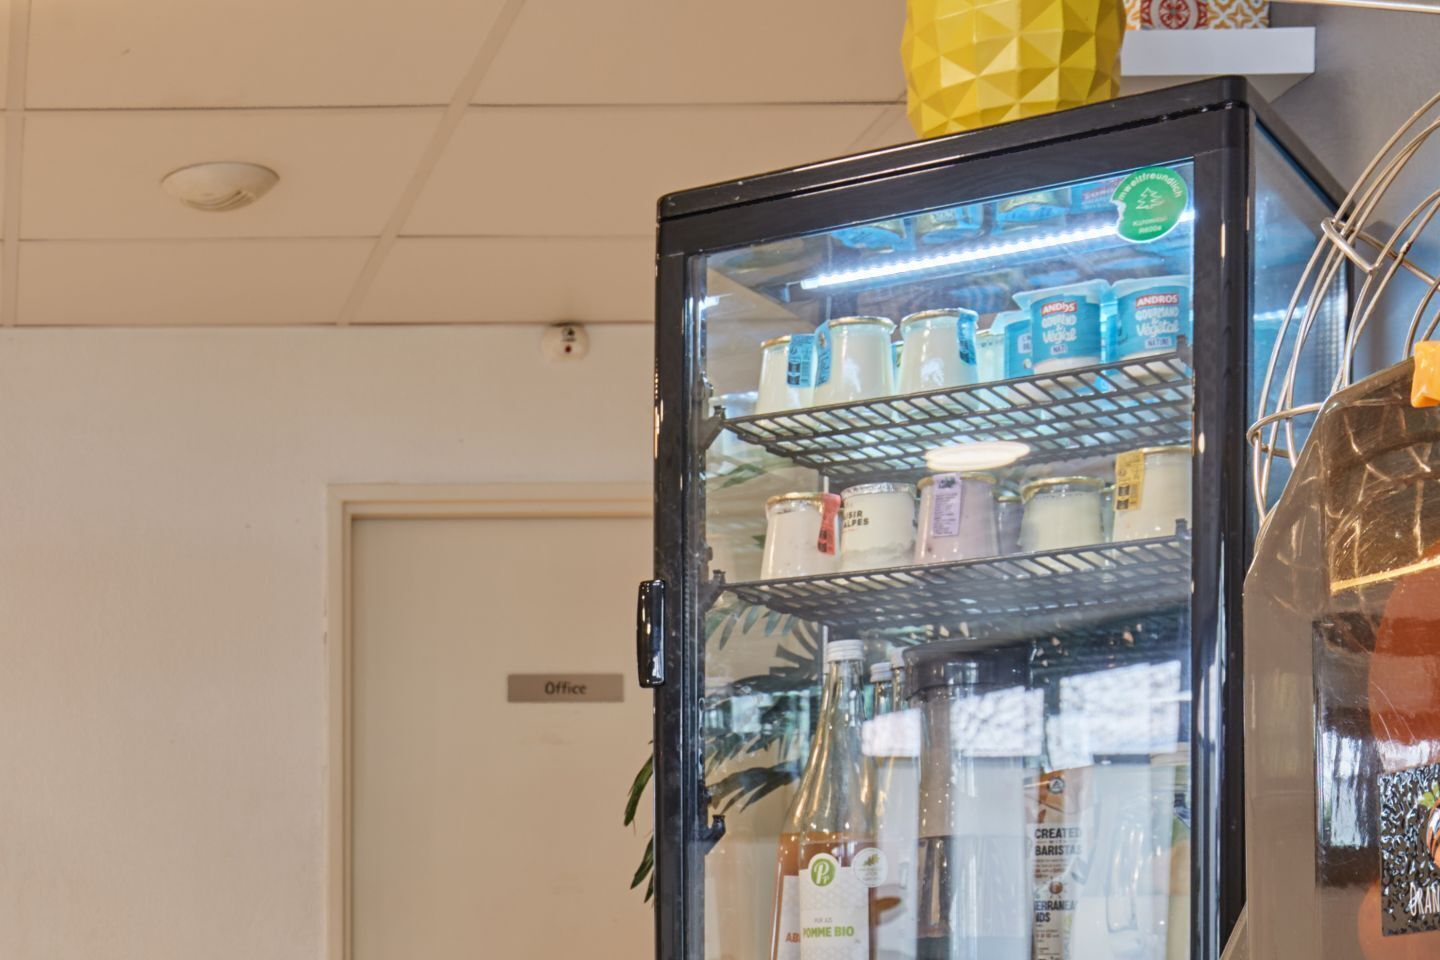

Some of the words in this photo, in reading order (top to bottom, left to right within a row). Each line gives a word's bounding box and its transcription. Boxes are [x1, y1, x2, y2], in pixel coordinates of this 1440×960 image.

[1118, 172, 1183, 200] mweltfreundlich
[1136, 294, 1179, 307] ANDROS
[544, 680, 587, 695] Office
[834, 926, 855, 937] BIO
